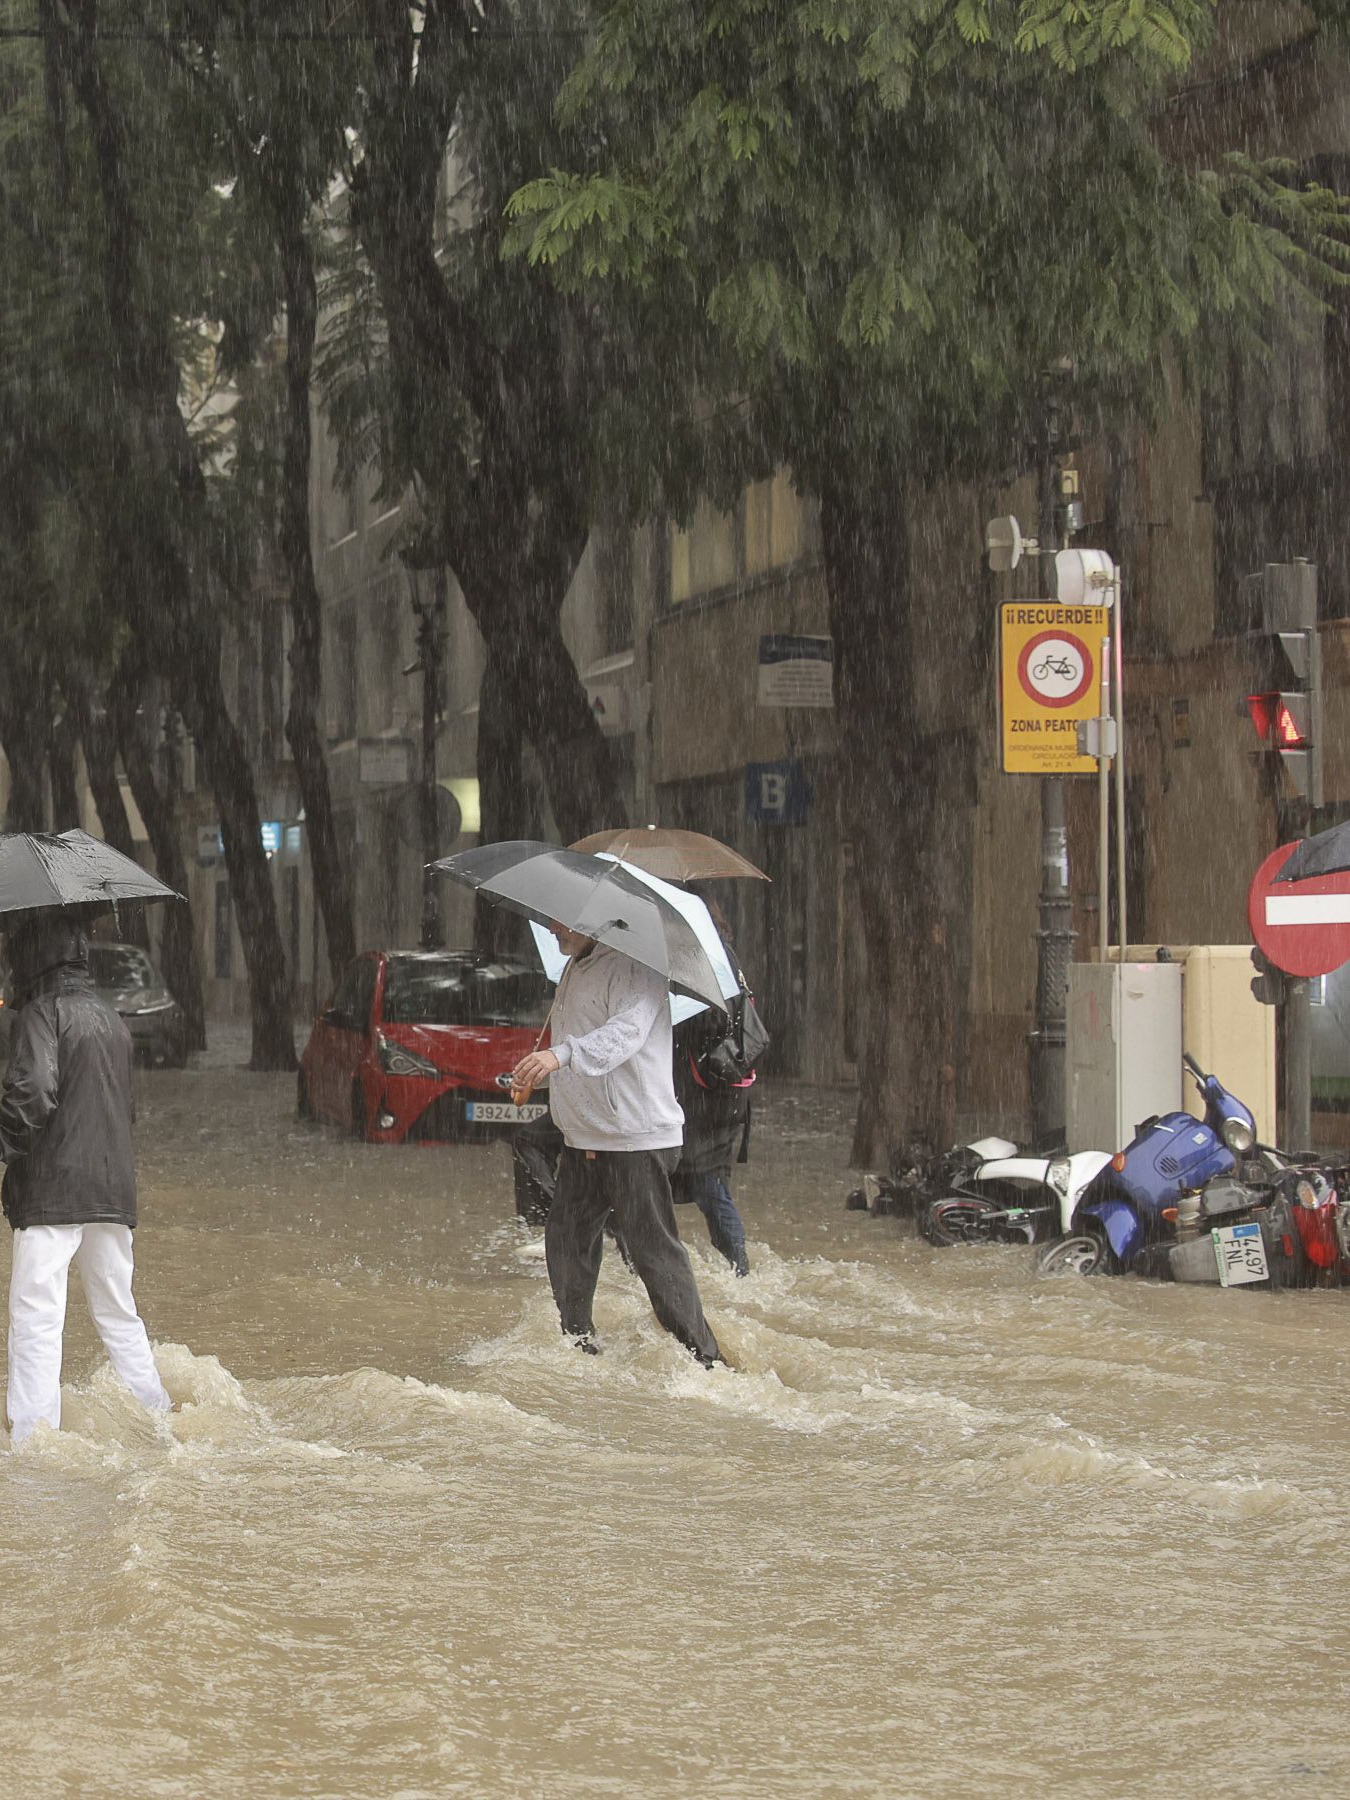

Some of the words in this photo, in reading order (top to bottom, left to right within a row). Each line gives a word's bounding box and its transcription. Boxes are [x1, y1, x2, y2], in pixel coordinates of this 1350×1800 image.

[1011, 719, 1042, 732] ZONA
[1045, 719, 1078, 732] PEATO
[476, 1106, 511, 1120] 3924
[1225, 1240, 1243, 1270] FNL
[1243, 1239, 1264, 1275] 4497
